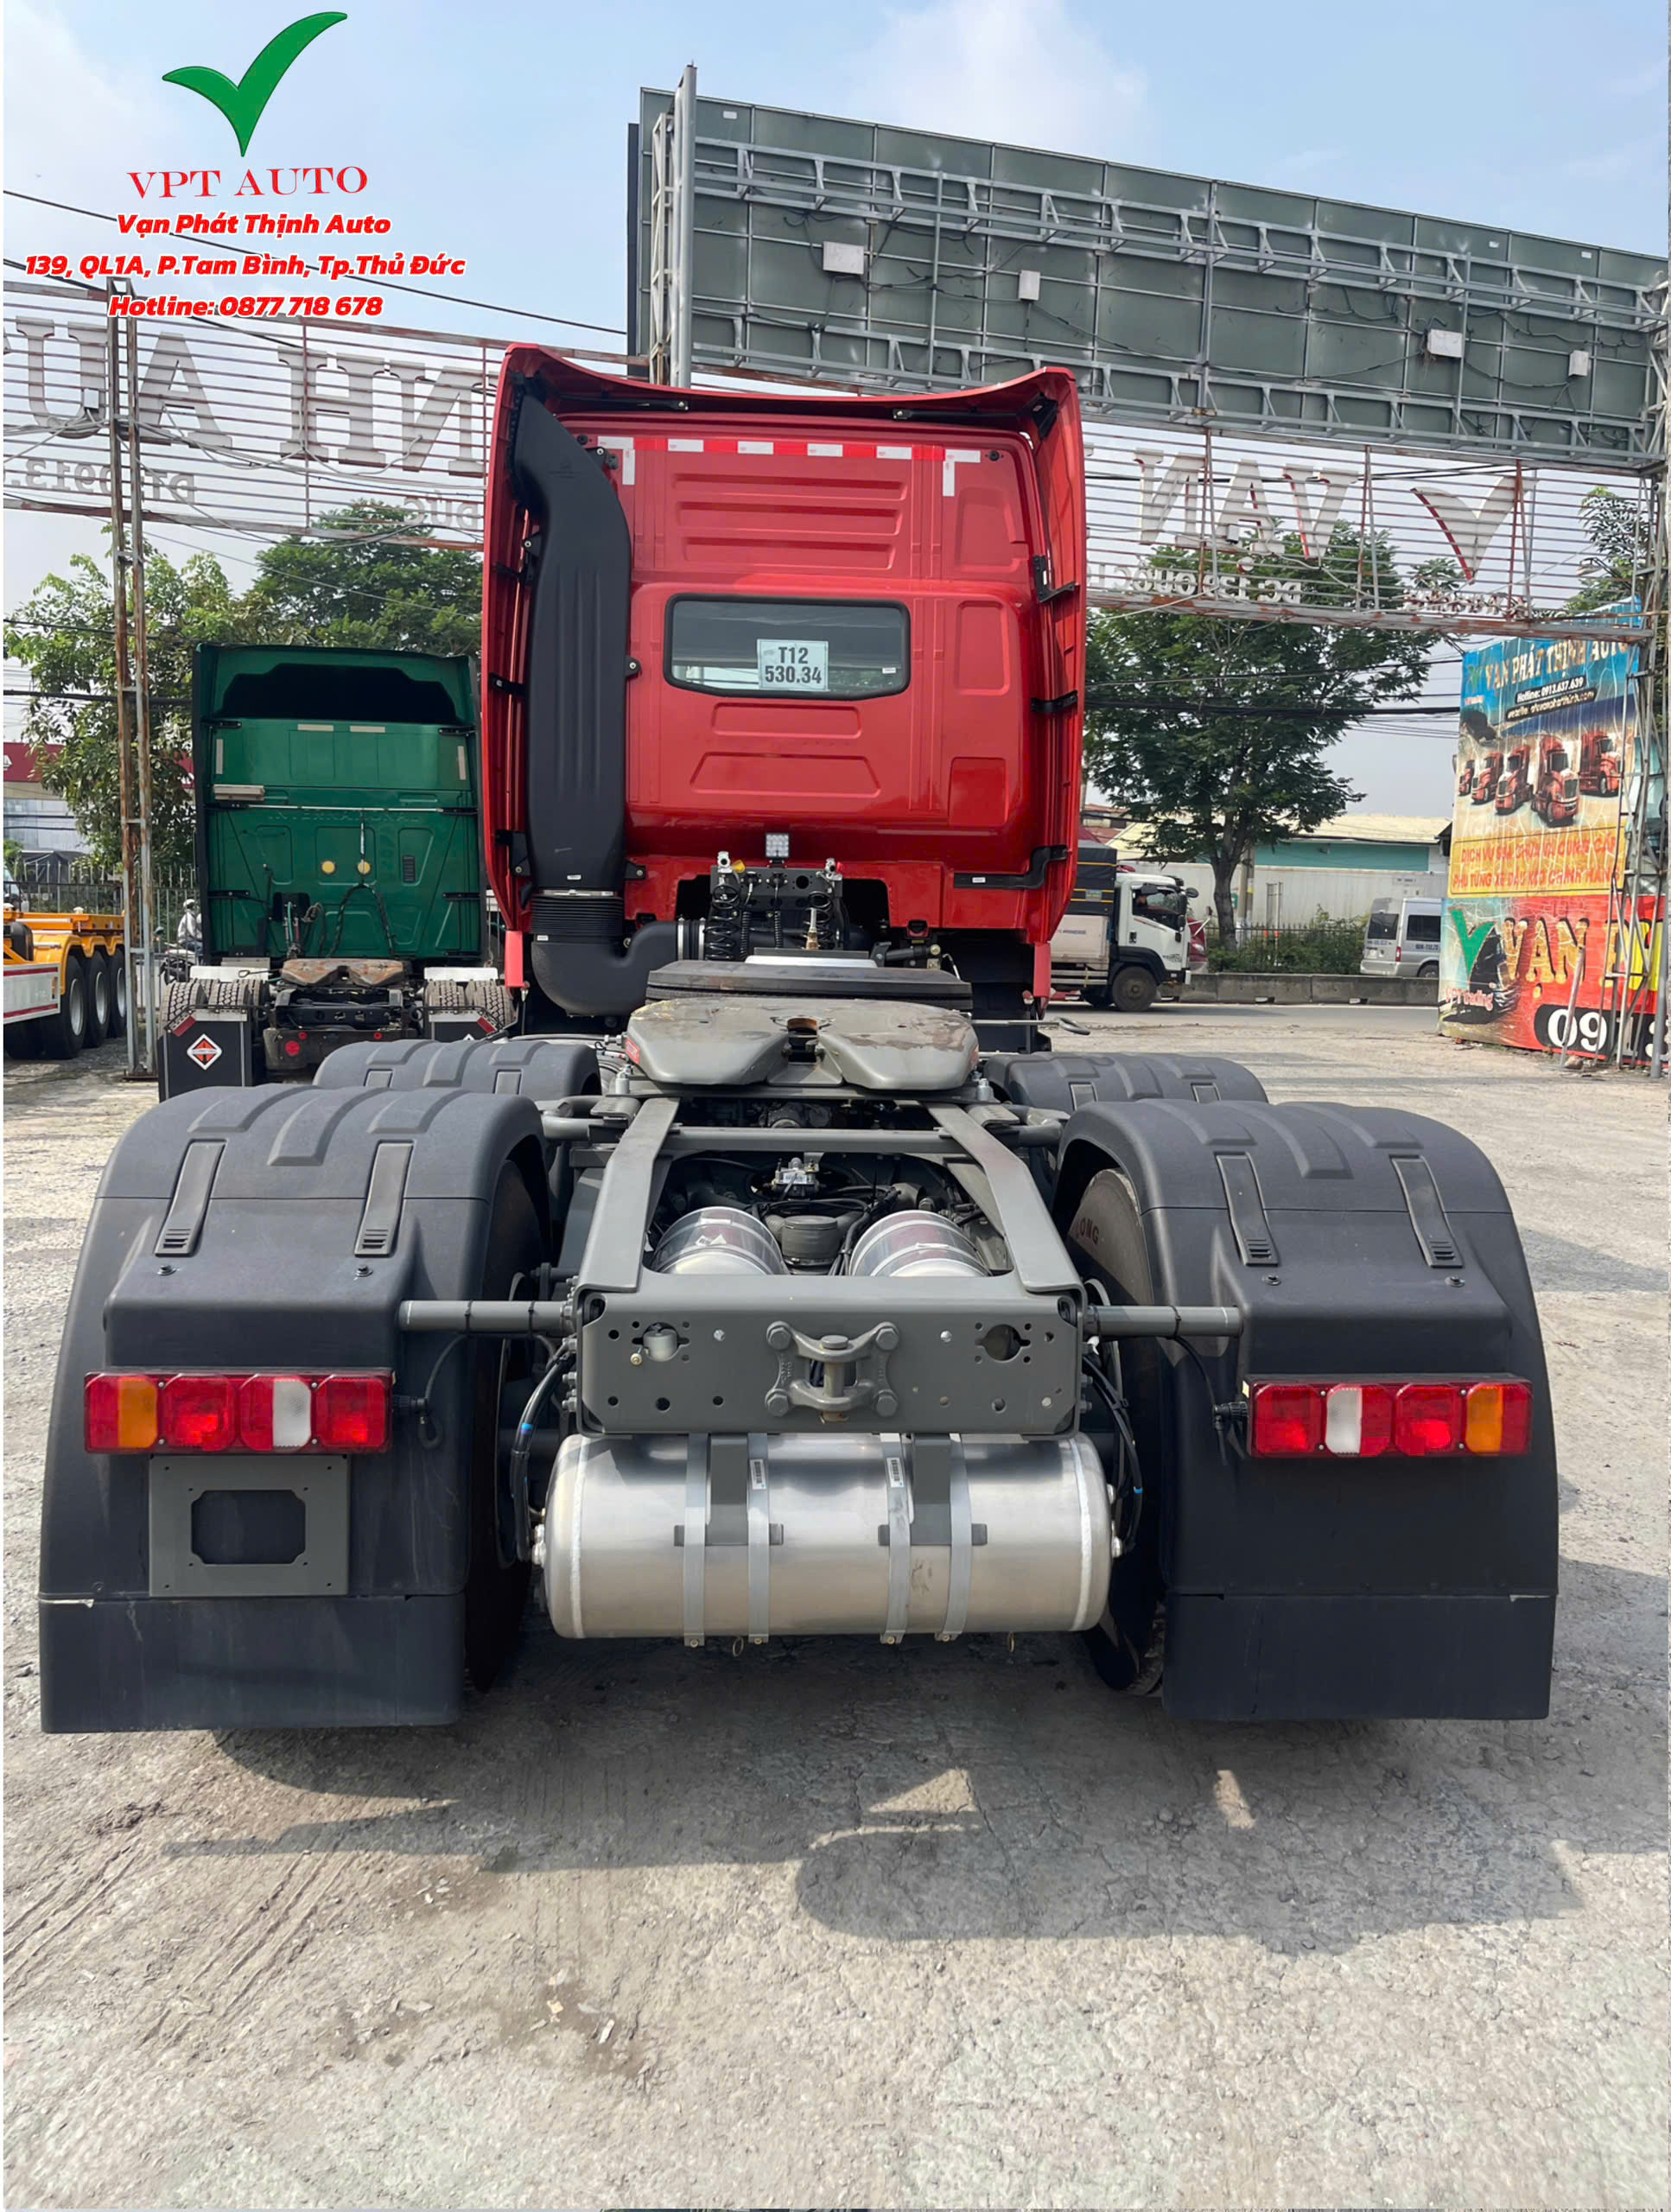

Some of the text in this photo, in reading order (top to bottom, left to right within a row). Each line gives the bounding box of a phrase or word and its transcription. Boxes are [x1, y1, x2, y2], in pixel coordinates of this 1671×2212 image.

[778, 646, 808, 664] T12
[1512, 643, 1544, 683] PHÁT
[765, 665, 822, 683] 530.34
[1502, 918, 1589, 1000] VẠN
